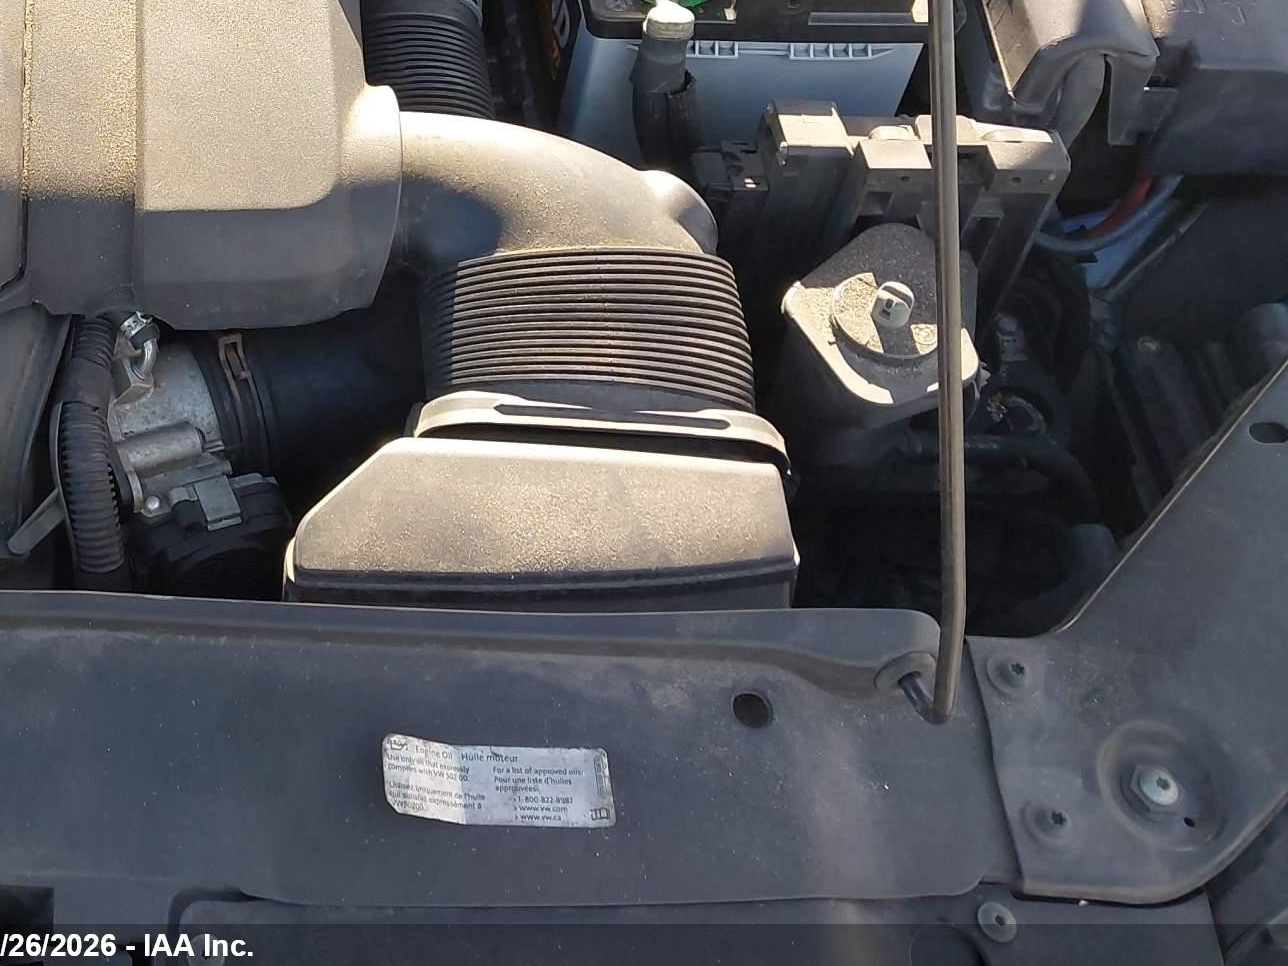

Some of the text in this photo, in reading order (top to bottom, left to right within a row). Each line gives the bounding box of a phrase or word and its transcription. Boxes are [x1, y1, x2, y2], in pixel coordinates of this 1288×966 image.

[415, 745, 453, 760] Engine Oil
[461, 753, 518, 762] Huile moteur
[524, 766, 532, 774] of
[534, 767, 567, 776] approved
[494, 776, 511, 784] Pour
